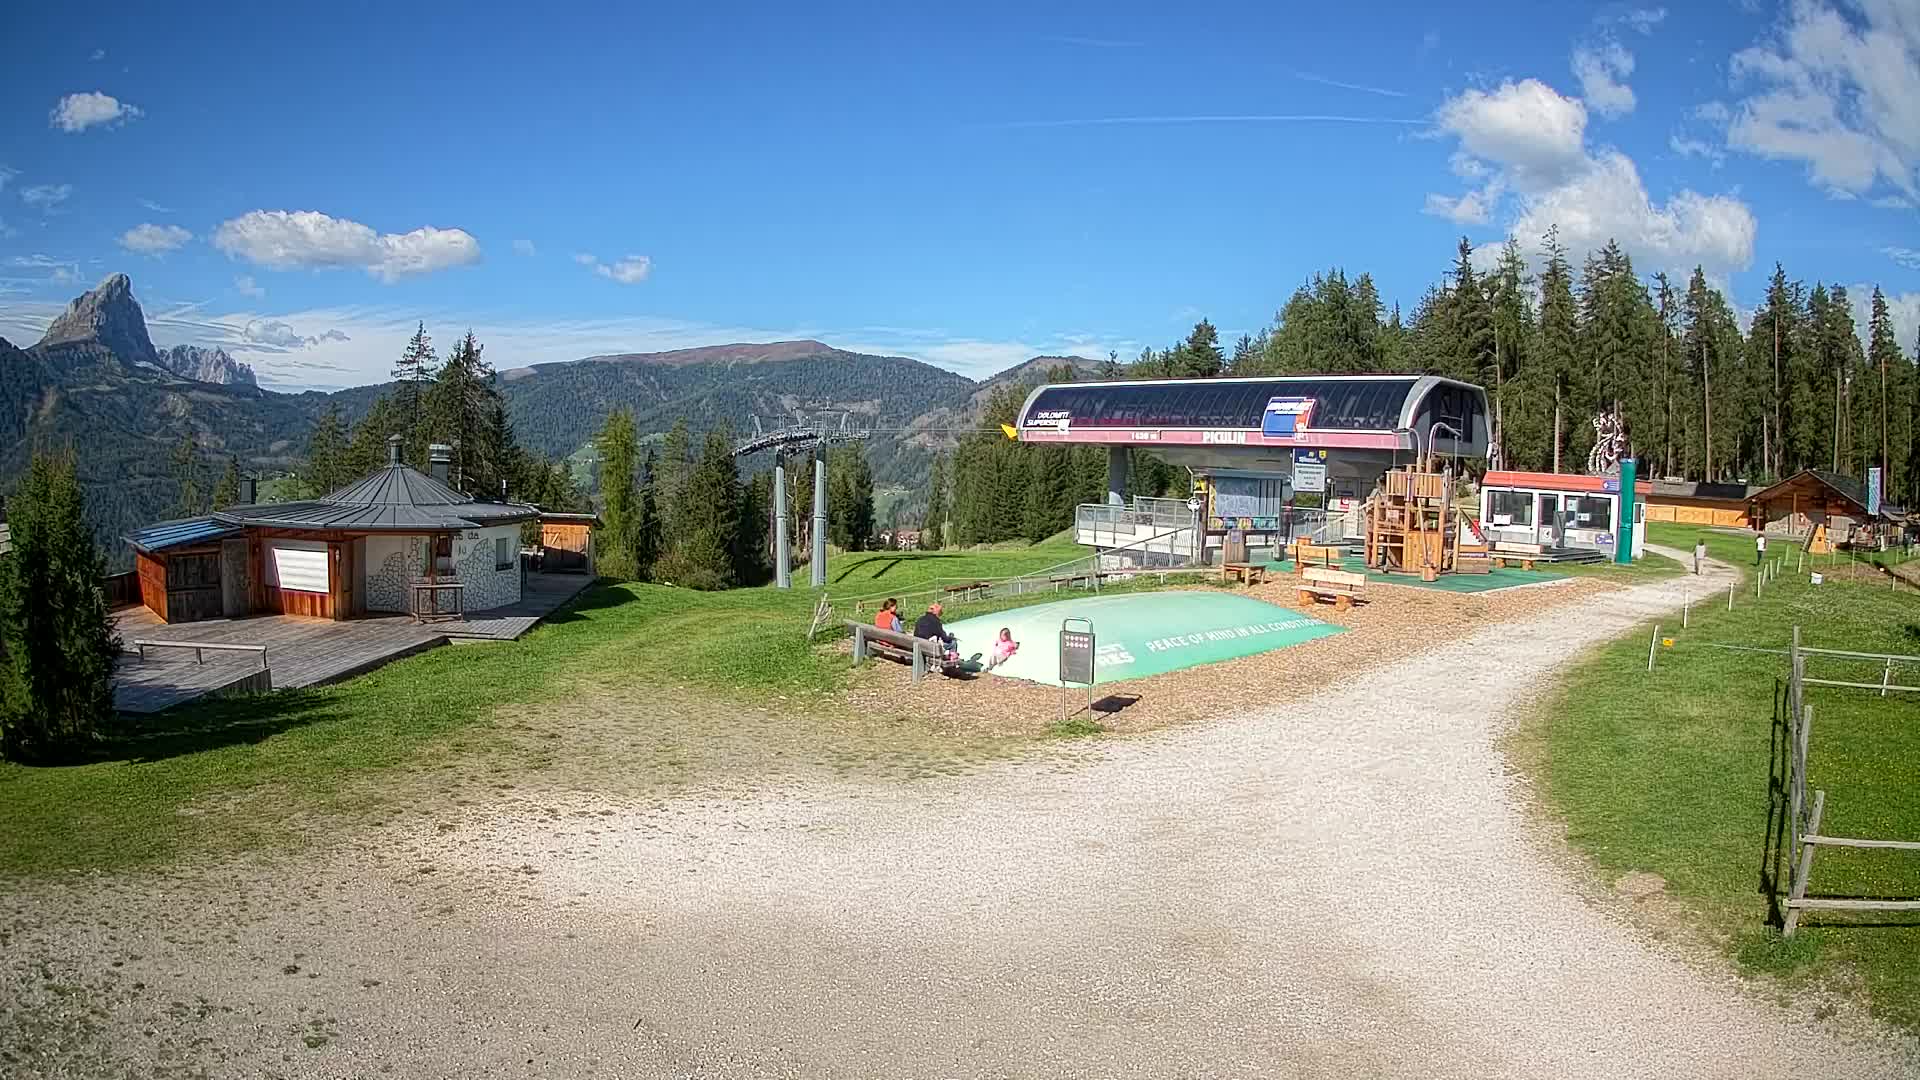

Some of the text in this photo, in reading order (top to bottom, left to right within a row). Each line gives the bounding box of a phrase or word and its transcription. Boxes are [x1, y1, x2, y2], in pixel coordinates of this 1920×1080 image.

[1202, 431, 1246, 445] PICULIN
[1145, 636, 1190, 652] PEACE
[1188, 633, 1204, 644] OF
[1205, 629, 1236, 641] MIND
[1233, 626, 1250, 637] IN
[1248, 623, 1270, 634] ALL
